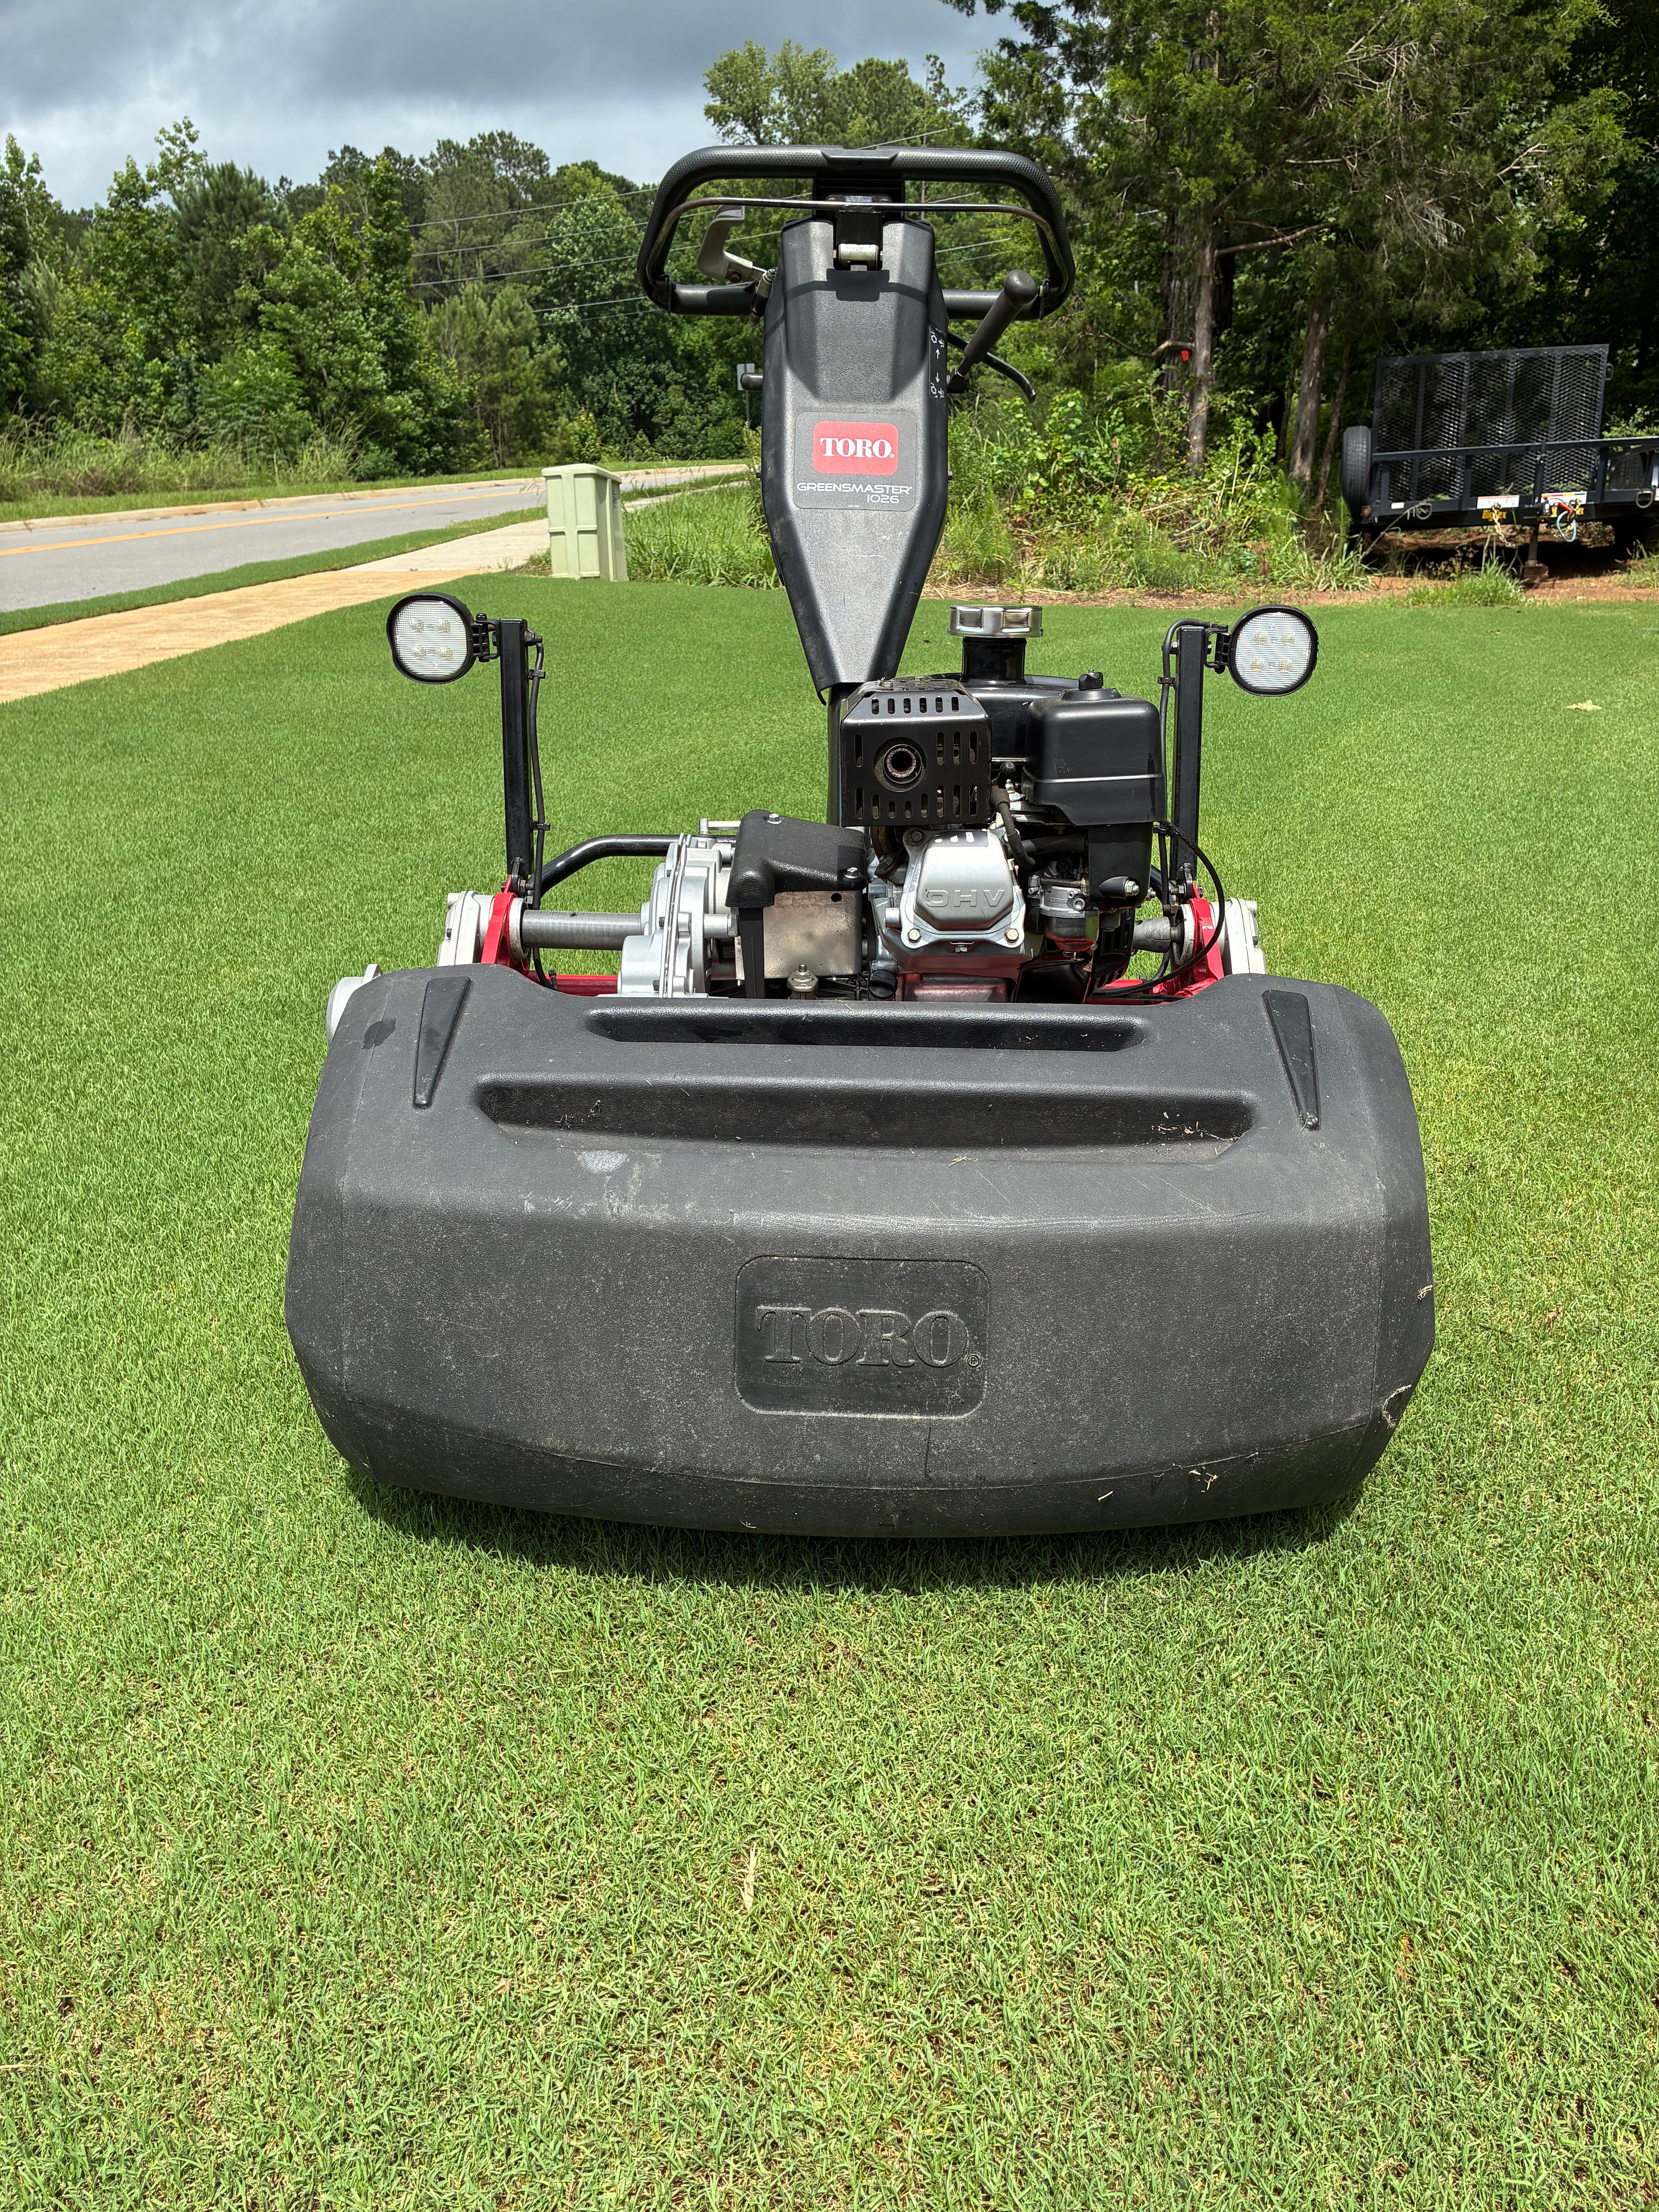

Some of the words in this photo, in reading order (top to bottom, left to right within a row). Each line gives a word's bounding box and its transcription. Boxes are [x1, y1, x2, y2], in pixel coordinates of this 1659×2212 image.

[820, 438, 892, 458] TORO
[797, 483, 909, 494] GREENSMASTER
[867, 494, 899, 504] 1026
[926, 890, 1004, 907] OHV
[756, 1304, 969, 1368] TORO
